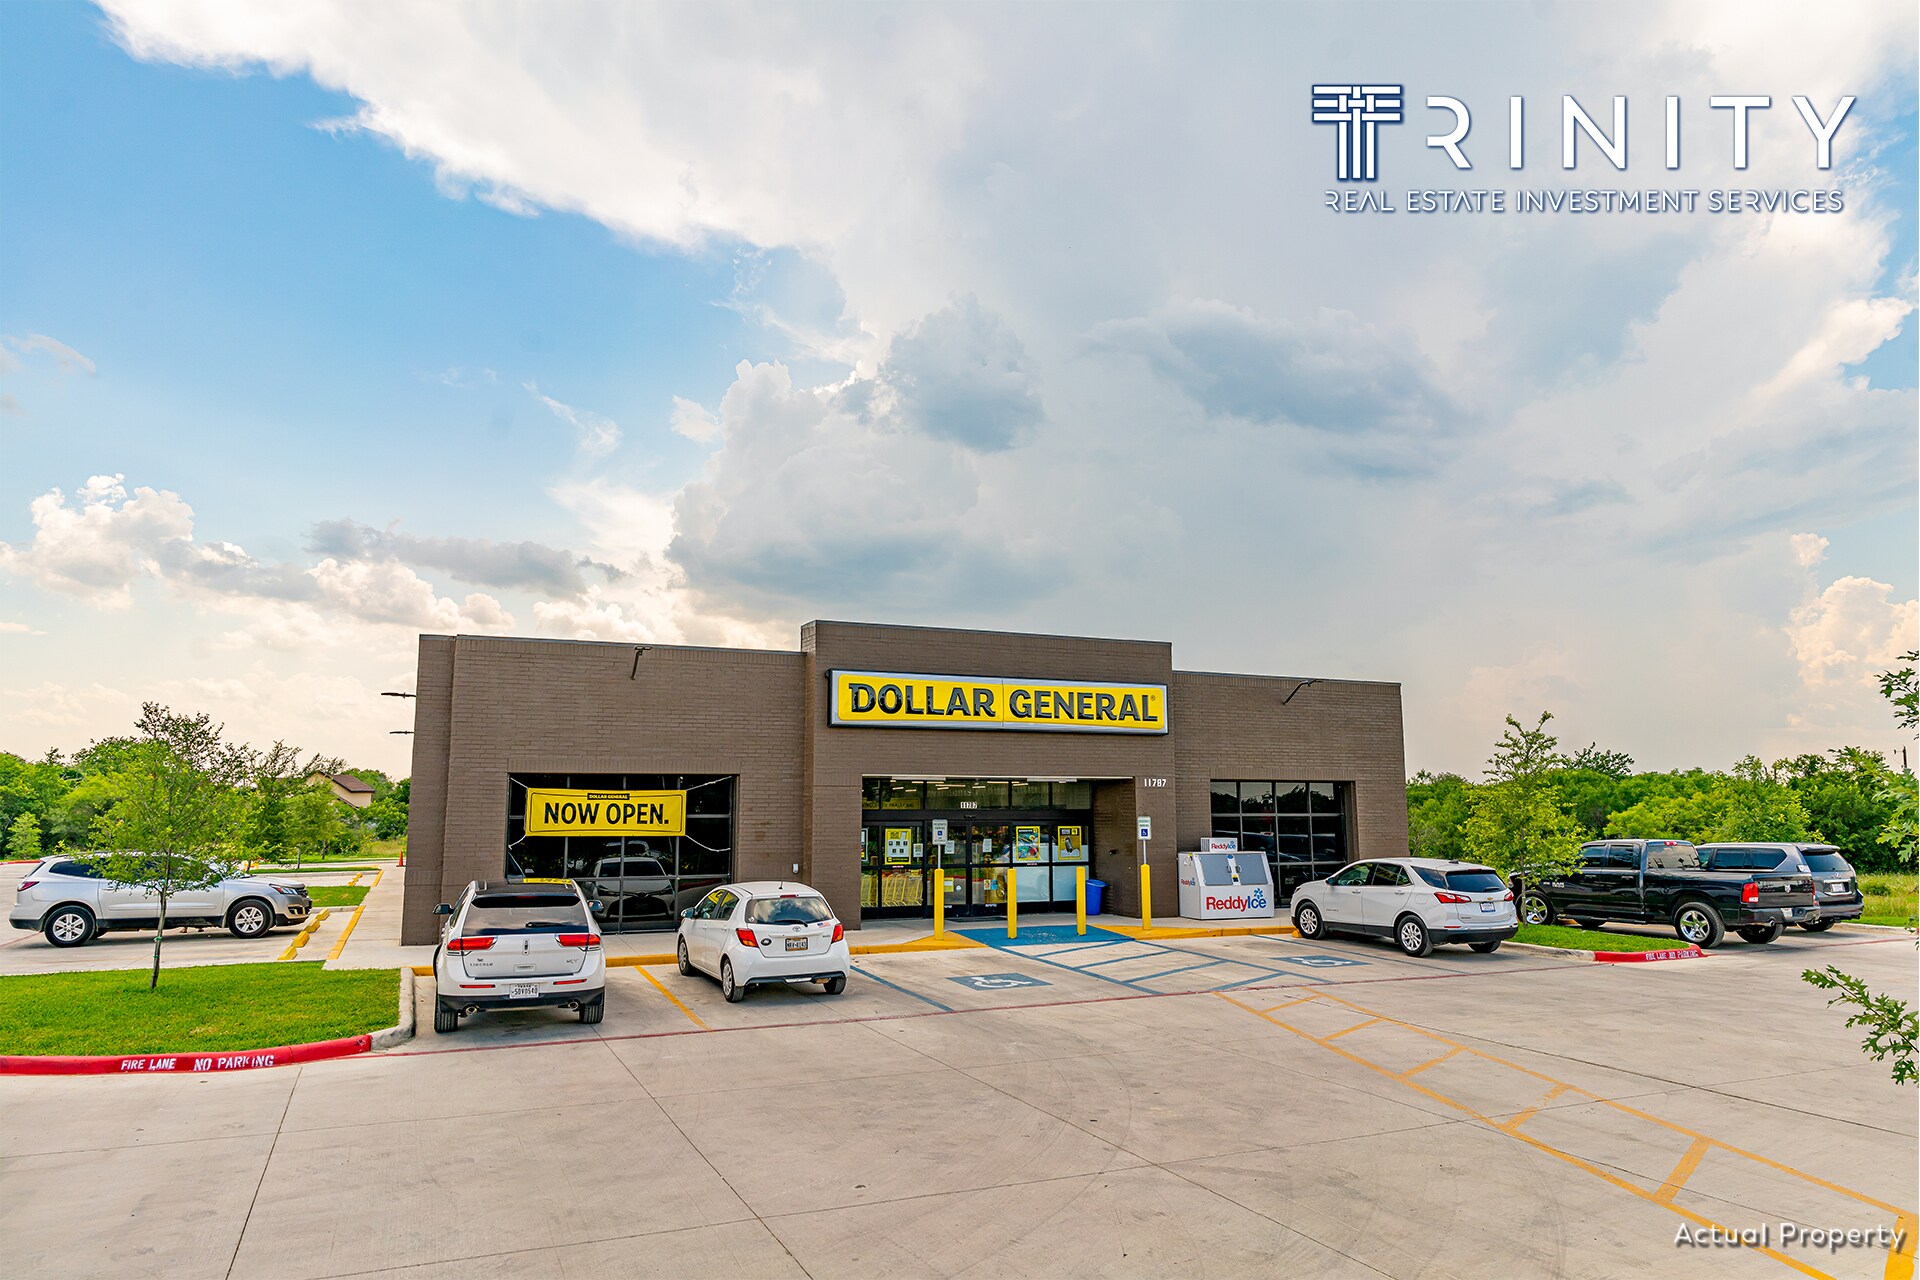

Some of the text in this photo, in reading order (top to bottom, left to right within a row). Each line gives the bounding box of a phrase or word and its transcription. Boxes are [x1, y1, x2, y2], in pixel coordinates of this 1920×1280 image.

[848, 682, 1158, 722] DOLLAR GENERAL
[1144, 778, 1167, 787] 11787
[544, 802, 669, 825] NOW OPEN.
[120, 1059, 146, 1070] FIRE
[148, 1058, 177, 1071] LANE
[193, 1058, 213, 1071] NO
